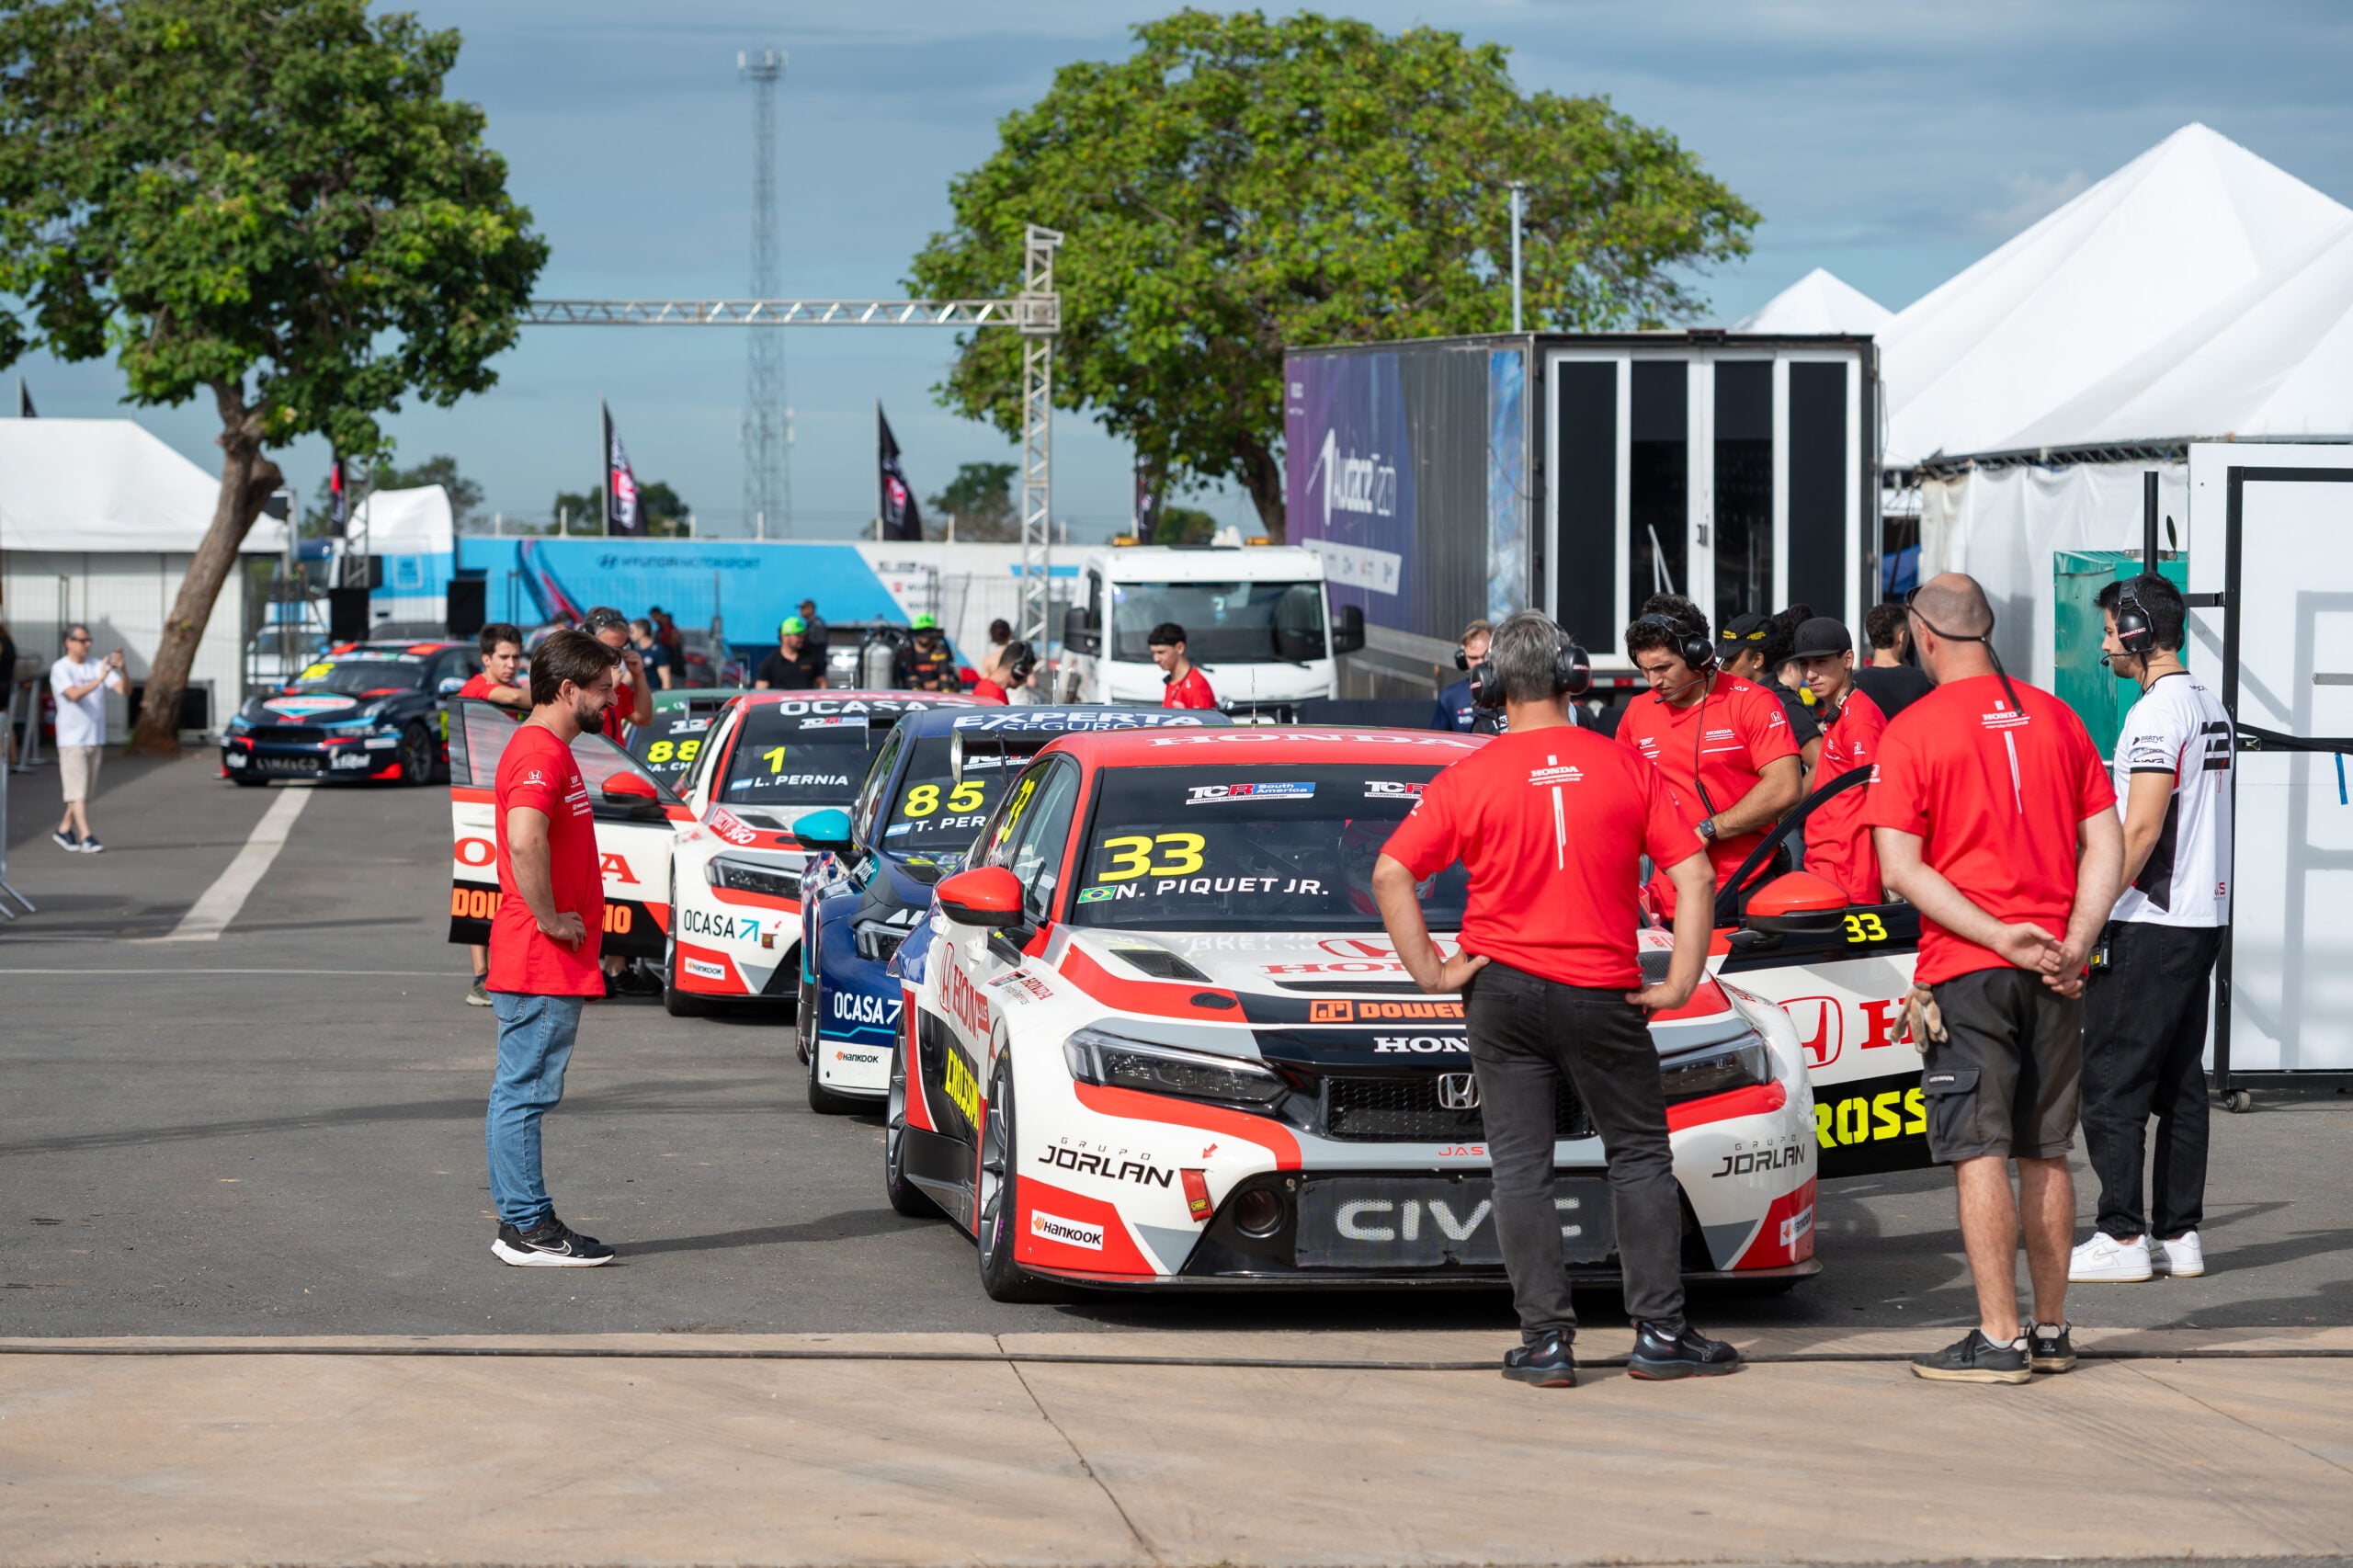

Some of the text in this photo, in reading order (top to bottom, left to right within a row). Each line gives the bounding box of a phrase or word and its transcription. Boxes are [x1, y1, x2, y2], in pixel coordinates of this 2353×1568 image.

[779, 700, 928, 715] OCASA
[1983, 711, 2026, 721] HOND
[953, 712, 1203, 729] EXPERTA
[1003, 722, 1156, 731] SEGURO
[647, 739, 701, 762] 88
[1149, 733, 1482, 748] HONDA
[762, 746, 786, 773] 1
[754, 775, 848, 788] L. PERNIA
[1531, 766, 1579, 777] HONDA
[904, 781, 985, 817] 85
[1188, 784, 1254, 798] TCR
[915, 820, 934, 832] T.
[1098, 833, 1205, 881] 33
[1116, 877, 1329, 900] N. PIQUET JR.
[684, 910, 735, 938] OCASA
[1845, 913, 1887, 943] 33
[834, 992, 885, 1025] OCASA
[1061, 1137, 1151, 1160] GRUPO
[1438, 1146, 1484, 1156] JAS
[1712, 1142, 1805, 1178] JORLAN
[1038, 1145, 1174, 1188] JORLAN
